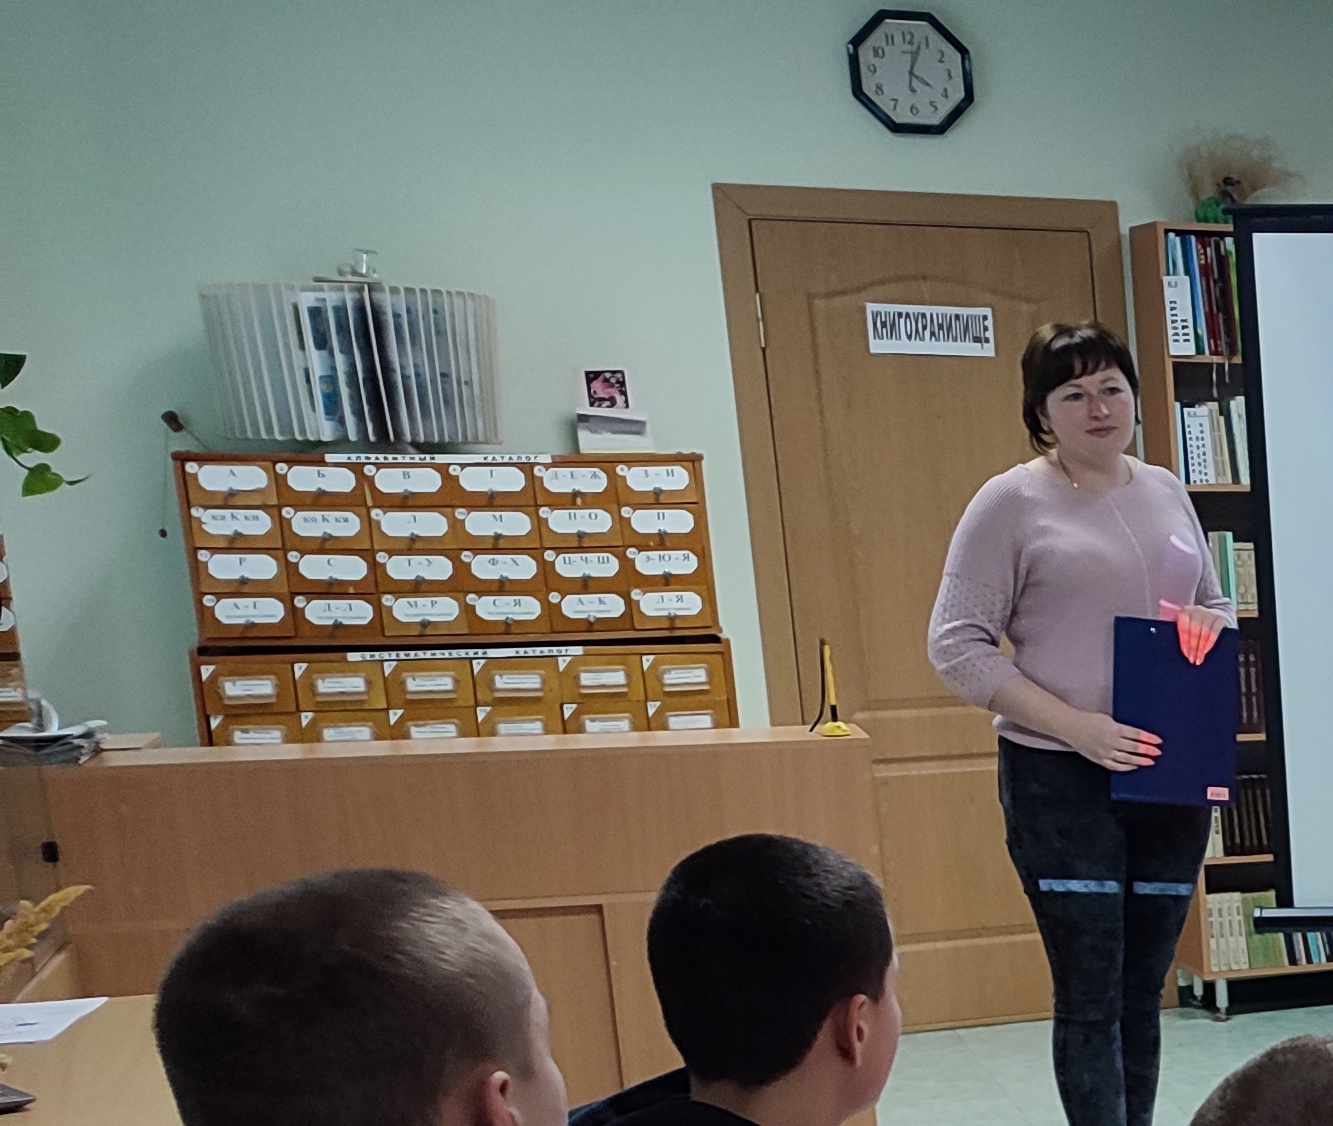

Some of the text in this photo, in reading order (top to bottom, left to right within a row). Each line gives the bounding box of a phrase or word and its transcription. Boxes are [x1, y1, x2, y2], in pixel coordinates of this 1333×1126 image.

[884, 32, 895, 46] 11
[902, 32, 914, 45] 12
[924, 36, 929, 49] 1
[873, 46, 885, 59] 10
[937, 50, 945, 63] 2
[867, 64, 877, 76] 9
[875, 83, 884, 96] 8
[941, 87, 948, 100] 4
[890, 98, 899, 111] 7
[910, 104, 919, 116] 6
[929, 101, 938, 113] 5
[871, 310, 990, 350] КНИГОХРАНИЛИЩЕ
[515, 648, 570, 656] КАТАЛОГ
